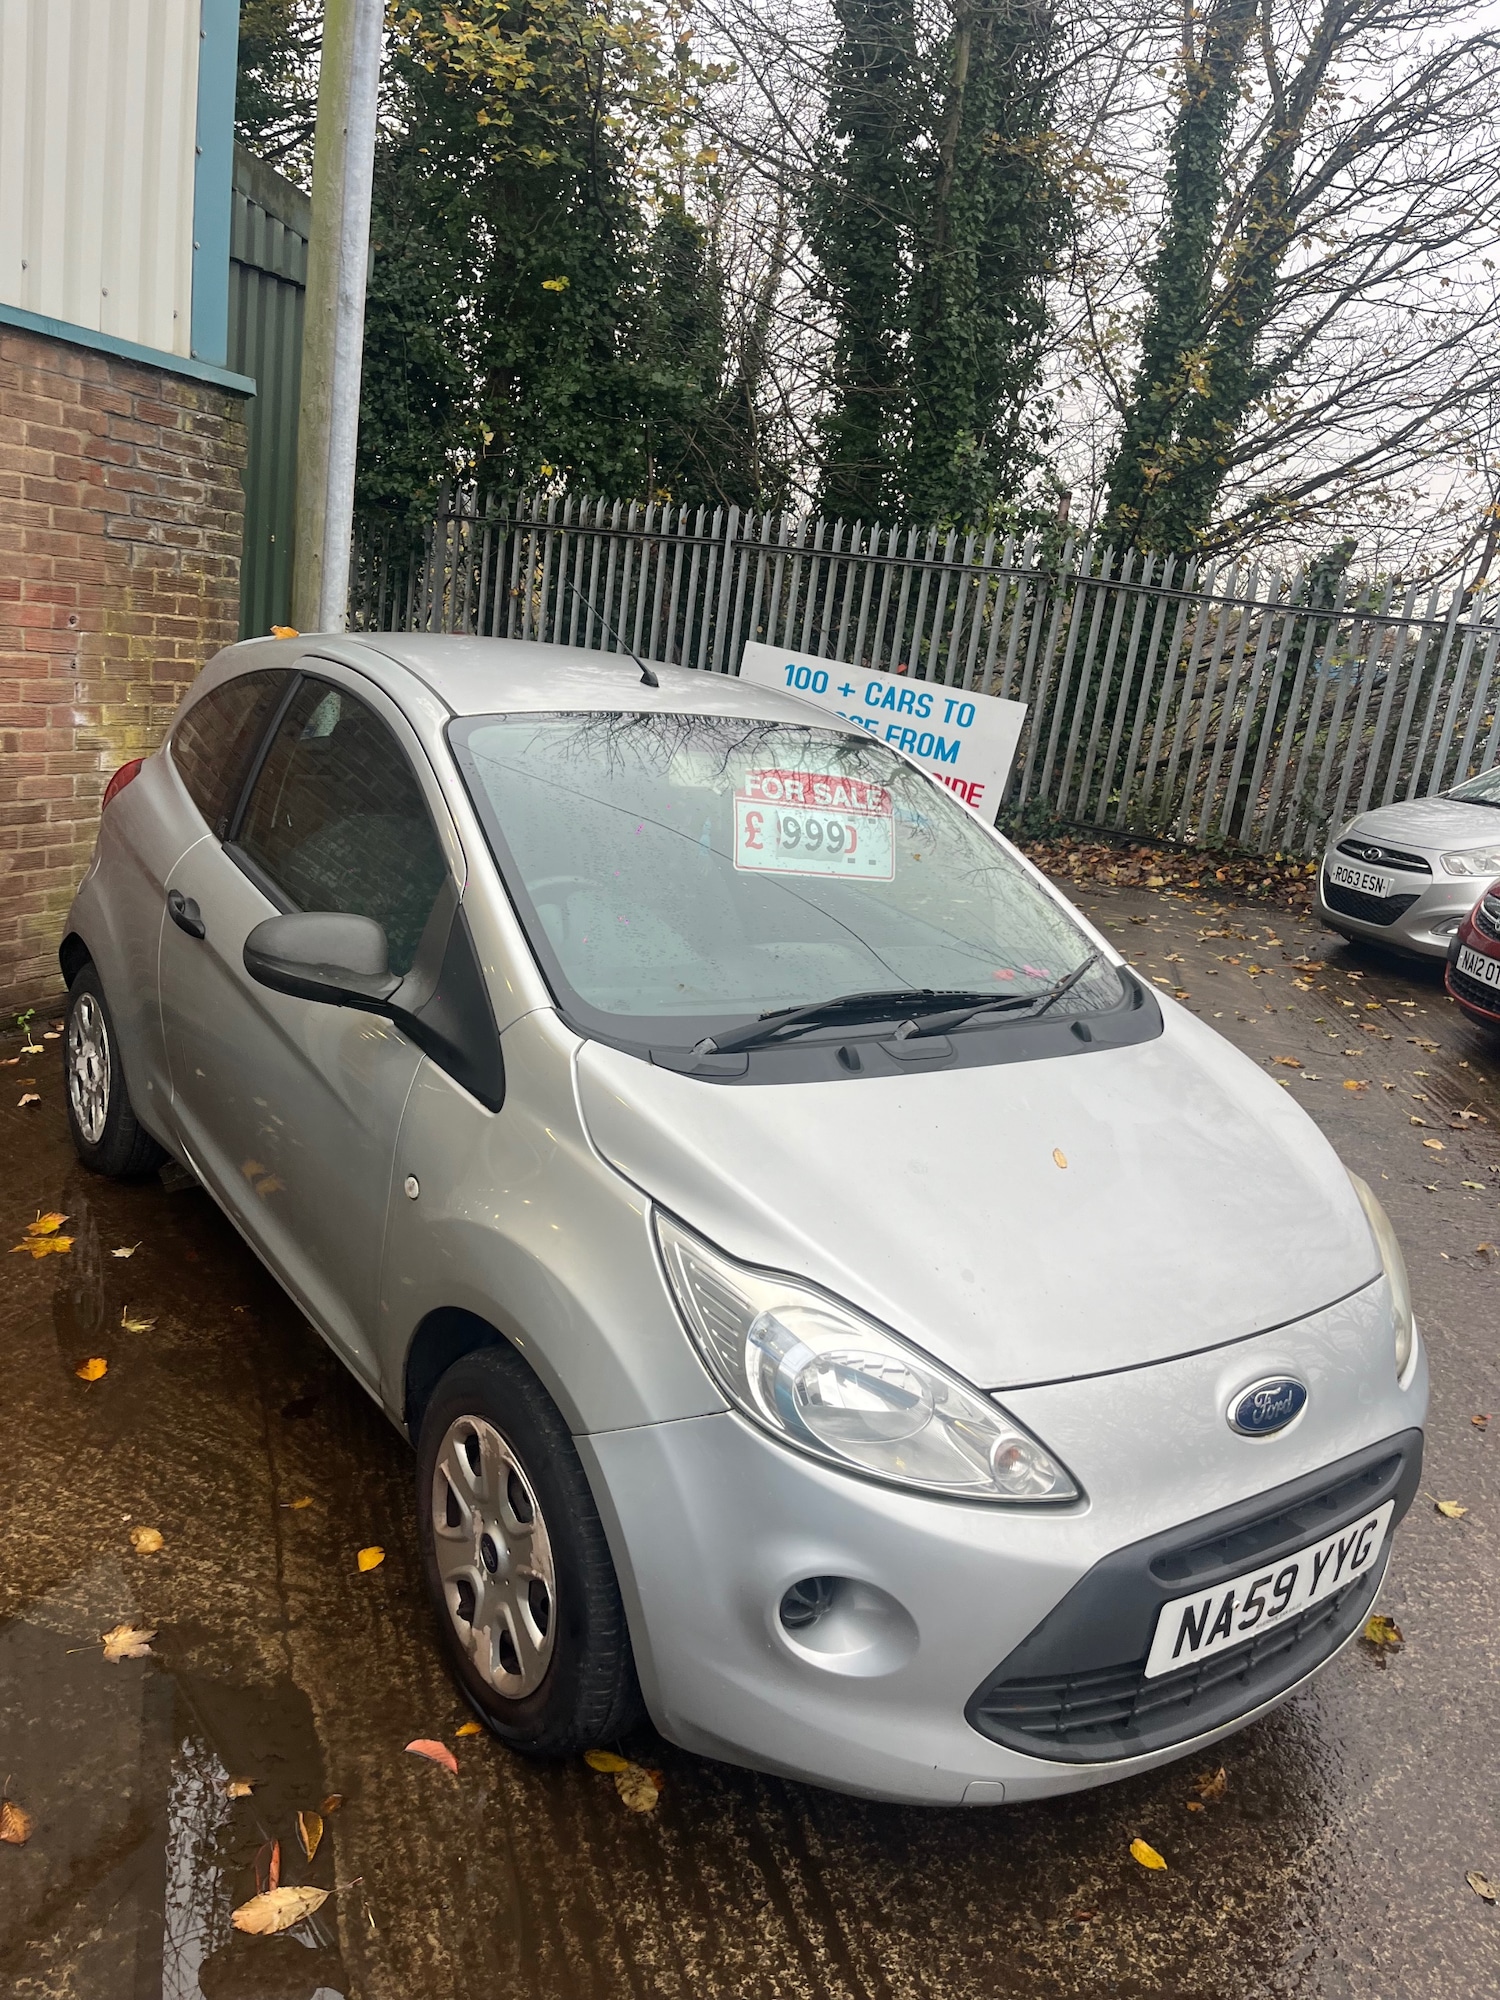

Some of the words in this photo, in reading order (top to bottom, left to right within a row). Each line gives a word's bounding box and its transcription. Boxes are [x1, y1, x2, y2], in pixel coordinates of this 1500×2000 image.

[784, 664, 829, 694] 100
[837, 683, 855, 697] +
[864, 681, 934, 718] CARS
[943, 698, 976, 728] TO
[885, 724, 961, 764] FROM
[744, 775, 804, 803] FOR
[813, 782, 882, 811] SALE
[744, 811, 764, 850] £
[1361, 873, 1384, 893] ESN
[1252, 1386, 1293, 1425] Ford
[1171, 1563, 1299, 1659] NA59
[1308, 1519, 1378, 1598] YYG
